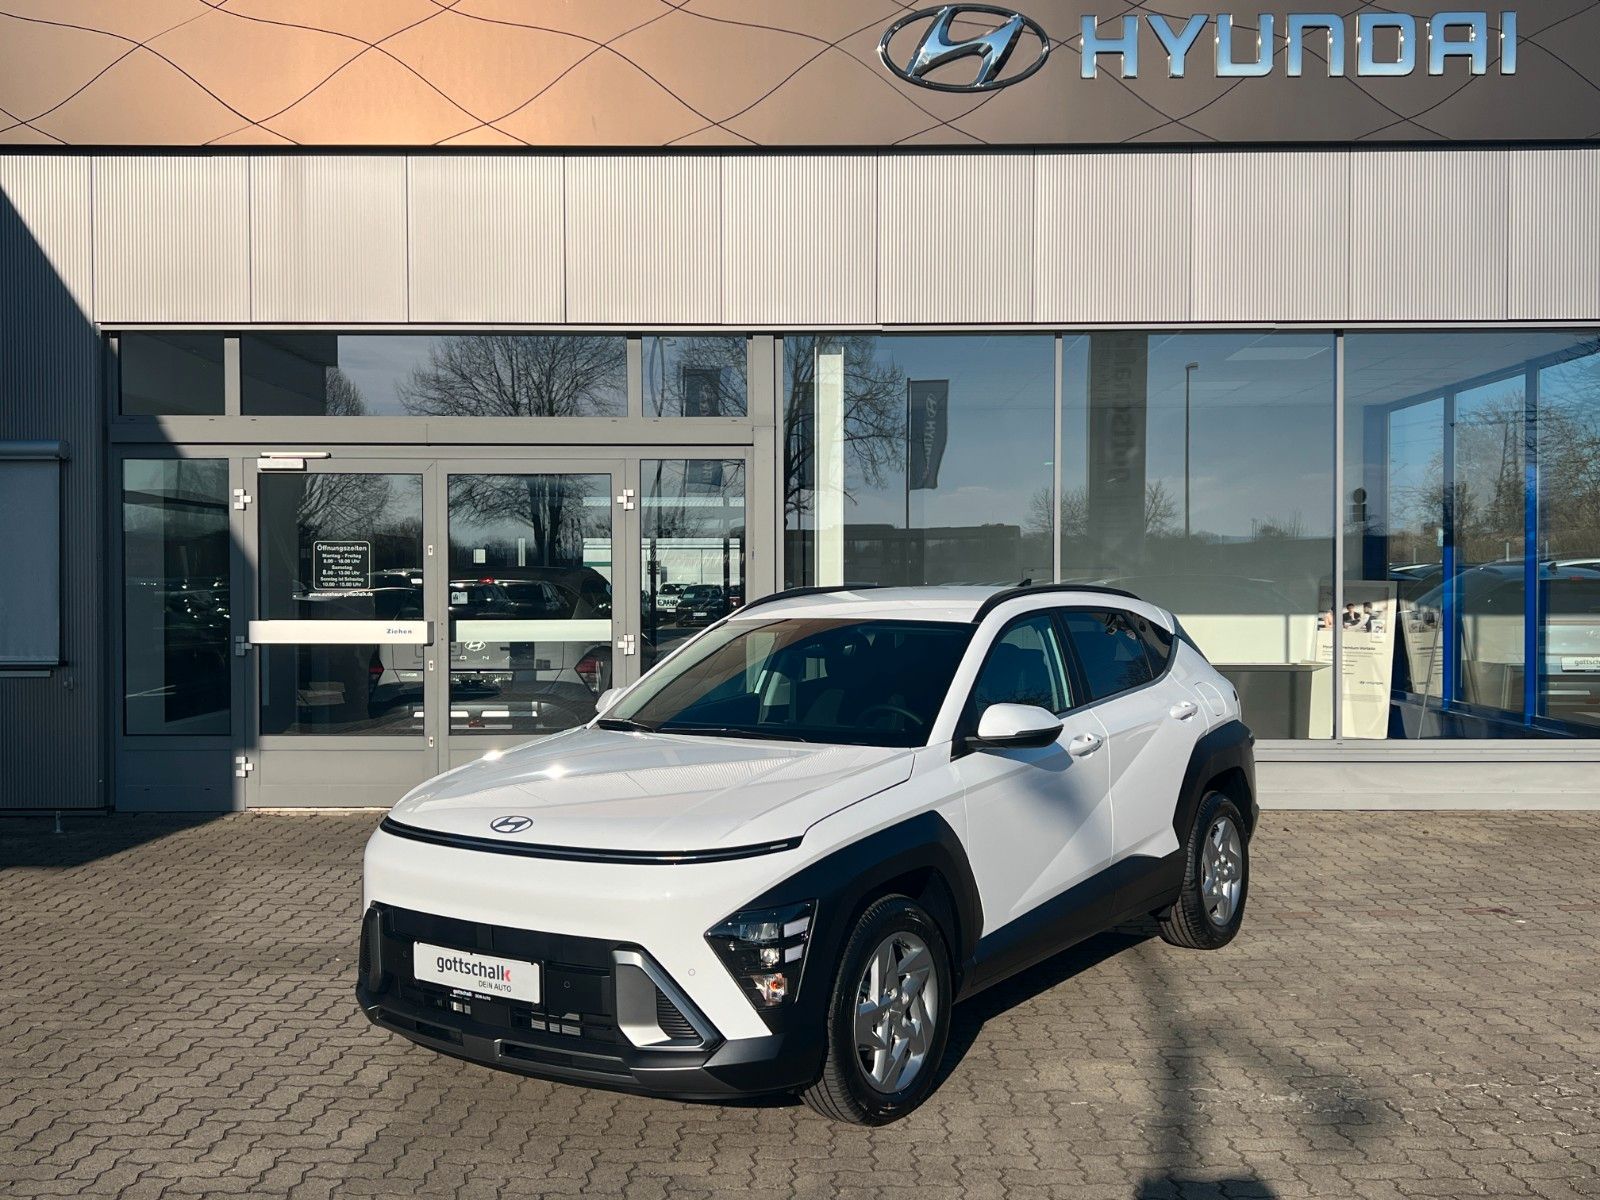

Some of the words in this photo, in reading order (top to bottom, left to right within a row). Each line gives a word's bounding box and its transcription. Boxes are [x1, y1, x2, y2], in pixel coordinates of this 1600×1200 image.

[1080, 11, 1517, 79] HYUNDAI
[437, 956, 511, 982] gottschalk
[478, 981, 493, 989] DEIN
[494, 983, 511, 992] AUTO
